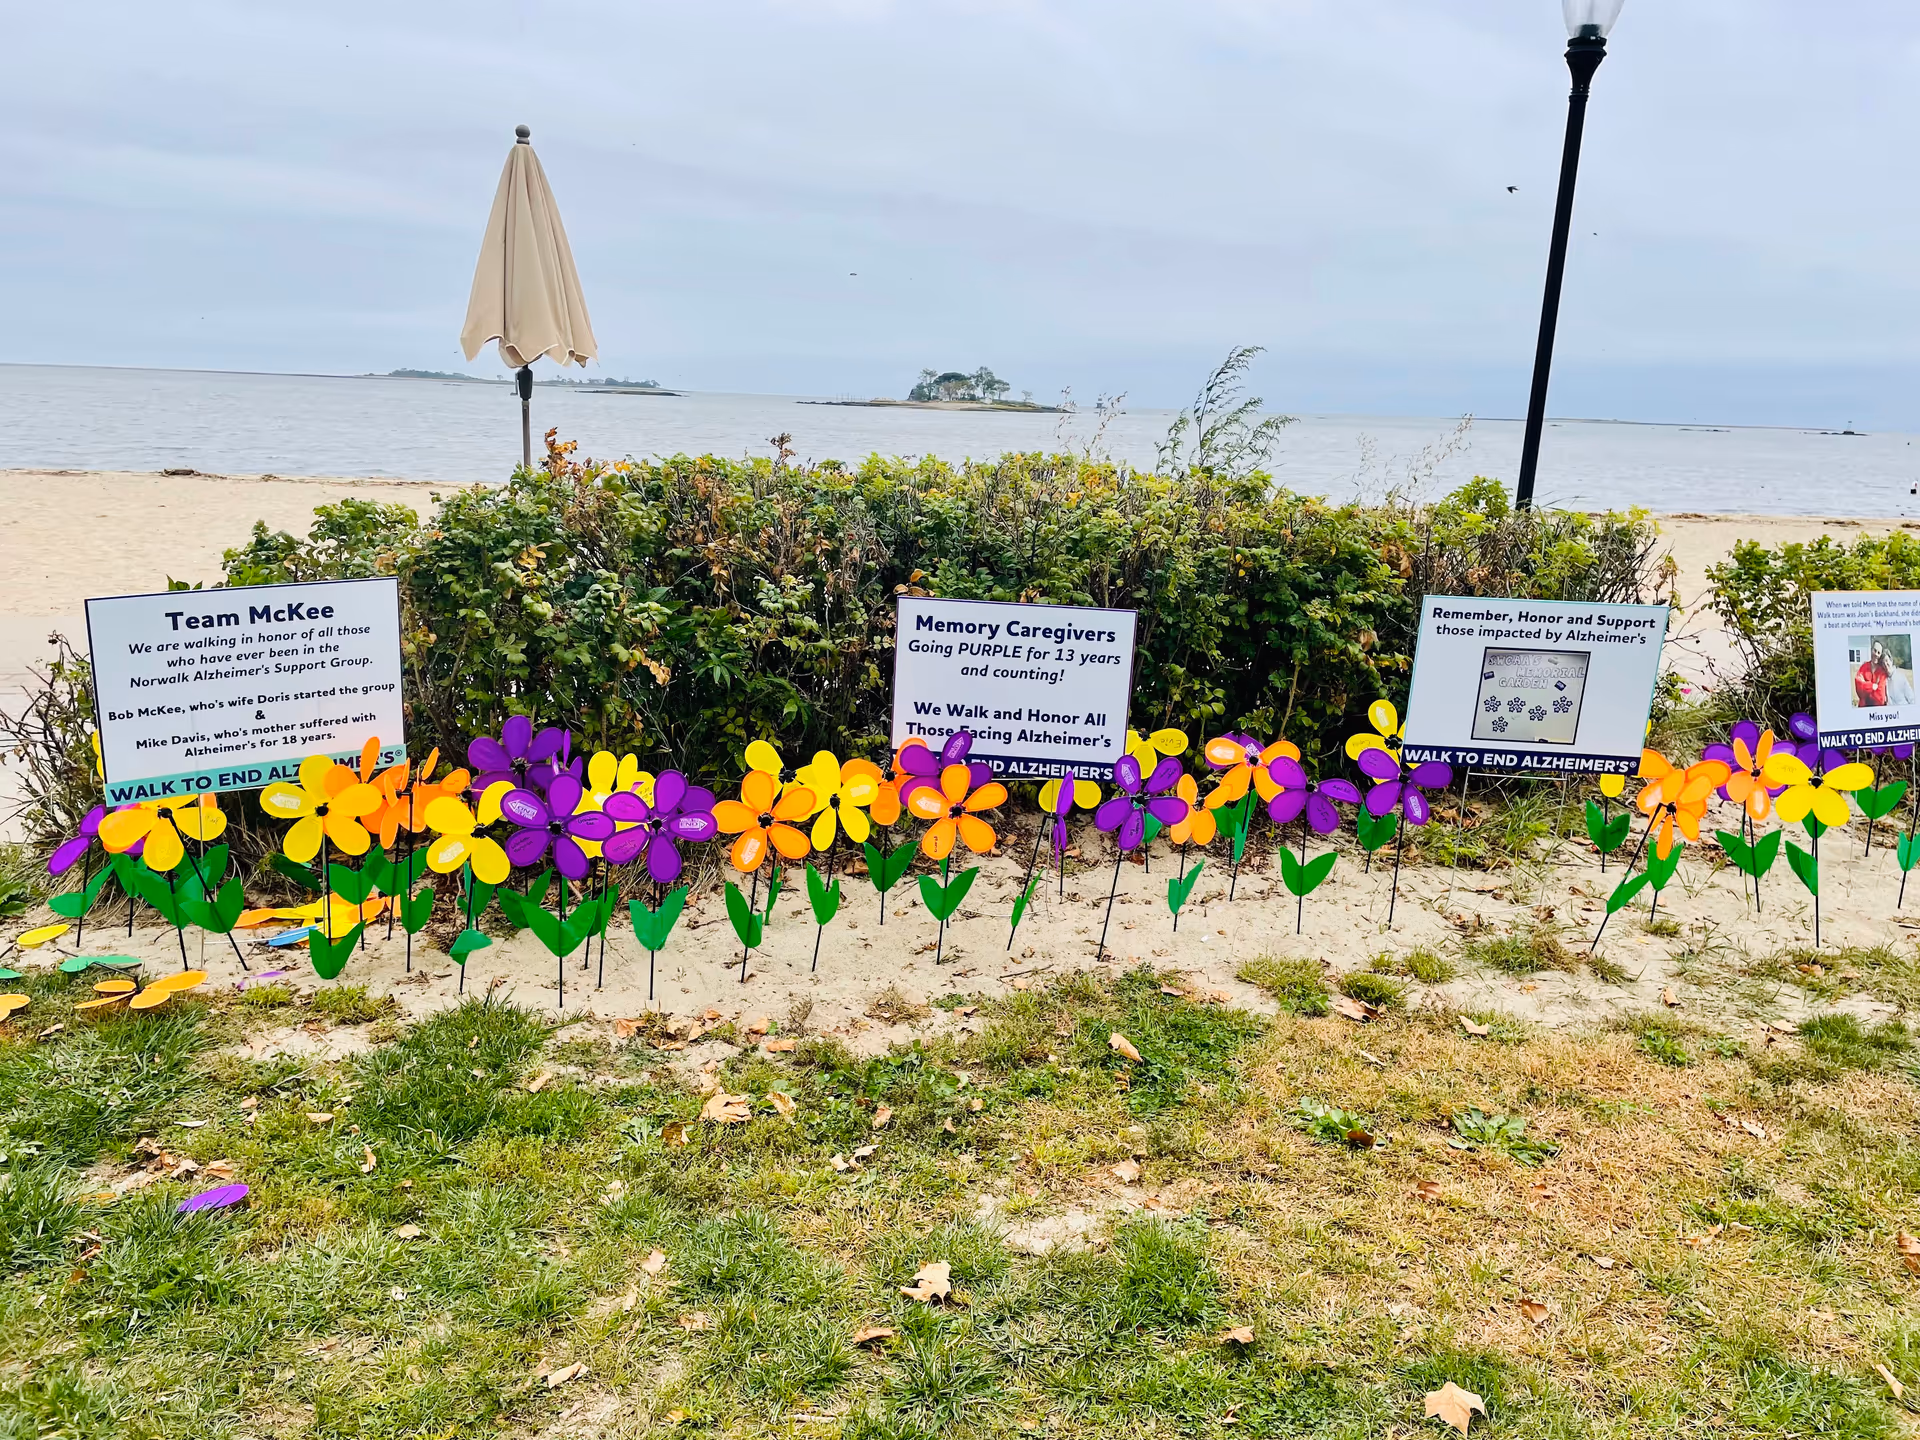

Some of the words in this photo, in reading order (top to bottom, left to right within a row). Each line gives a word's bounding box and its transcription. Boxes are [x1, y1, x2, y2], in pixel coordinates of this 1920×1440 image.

[165, 613, 240, 631] Team
[249, 602, 334, 625] McKee
[1432, 607, 1513, 624] Remember,
[1518, 611, 1561, 624] Honor
[1567, 614, 1593, 626] and
[1597, 614, 1655, 630] Support
[129, 644, 152, 655] We
[156, 641, 180, 652] are
[184, 636, 237, 653] walking
[241, 635, 253, 645] in
[257, 631, 297, 643] honor
[301, 628, 315, 641] of
[318, 627, 334, 639] all
[337, 624, 370, 637] those
[916, 615, 1000, 640] Memory
[1006, 621, 1116, 643] Caregivers
[1436, 624, 1474, 636] those
[1478, 625, 1541, 640] impacted
[1546, 628, 1562, 643] by
[1565, 629, 1646, 644] Alzheimer's
[167, 655, 196, 668] who
[200, 652, 232, 665] have
[236, 651, 265, 661] ever
[269, 646, 299, 659] been
[303, 644, 315, 656] in
[319, 642, 340, 654] the
[908, 640, 953, 657] Going
[958, 643, 1022, 659] PURPLE
[1026, 648, 1050, 662] for
[1055, 649, 1074, 662] 13
[1079, 652, 1121, 666] years
[1488, 654, 1542, 666] SWCAA'S
[130, 672, 190, 688] Norwalk
[193, 664, 270, 682] Alzheimer's
[274, 658, 326, 677] Support
[330, 656, 373, 671] Group.
[961, 664, 988, 677] and
[993, 667, 1065, 684] counting!
[1499, 677, 1548, 689] GARDEN
[1516, 667, 1585, 678] MEMORIAL
[108, 710, 134, 721] Bob
[138, 705, 185, 718] McKee,
[189, 700, 224, 712] who's
[228, 696, 254, 708] wife
[258, 692, 290, 704] Doris
[293, 687, 335, 701] started
[339, 685, 358, 696] the
[361, 683, 395, 697] group
[914, 701, 942, 716] We
[947, 703, 989, 718] Walk
[994, 707, 1022, 721] and
[1027, 709, 1079, 726] Honor
[1084, 713, 1106, 726] All
[254, 710, 266, 720] &
[1869, 712, 1883, 720] Miss
[1885, 711, 1899, 722] you!
[136, 737, 168, 750] Mike
[171, 732, 210, 746] Davis,
[214, 727, 248, 740] who's
[252, 721, 296, 736] mother
[299, 714, 348, 730] suffered
[351, 712, 376, 724] with
[906, 722, 954, 737] Those
[1017, 729, 1111, 748] Alzheimer's
[1160, 738, 1182, 748] Evie
[1821, 734, 1848, 748] WALK
[1849, 733, 1863, 745] TO
[1865, 731, 1885, 744] END
[184, 740, 256, 757] Alzheimer's
[260, 737, 278, 748] for
[282, 733, 297, 744] 18
[301, 731, 336, 746] years.
[1404, 749, 1451, 763] WALK
[1455, 752, 1479, 764] TO
[1483, 754, 1518, 767] END
[1008, 761, 1113, 780] ALZHEIMER'S
[110, 781, 175, 802] WALK
[181, 776, 212, 792] TO
[218, 770, 262, 787] END
